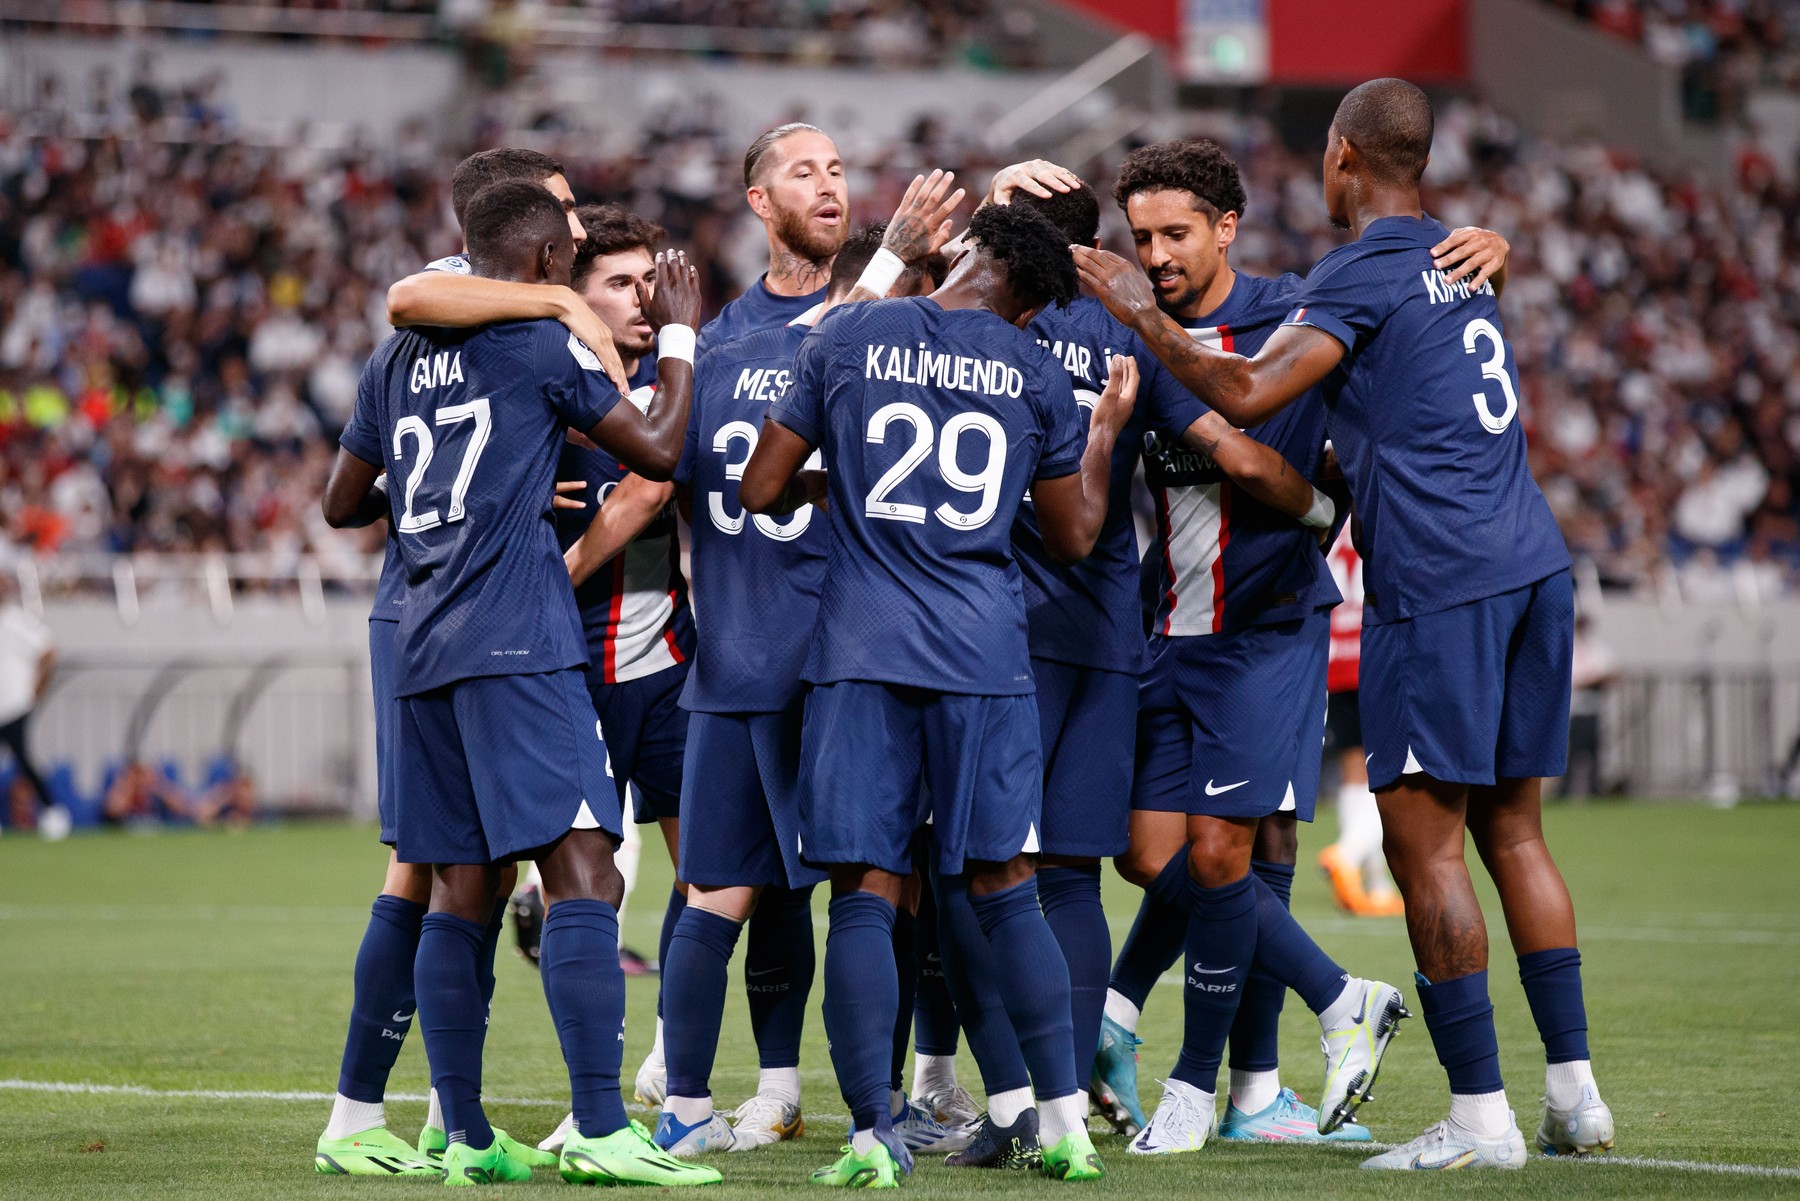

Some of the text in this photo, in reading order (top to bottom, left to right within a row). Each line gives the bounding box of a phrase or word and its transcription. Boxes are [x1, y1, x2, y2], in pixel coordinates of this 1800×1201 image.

[410, 351, 465, 393] GANA
[1463, 318, 1518, 434] 3
[393, 398, 492, 534] 27
[865, 402, 1008, 531] 29
[1165, 454, 1217, 473] AIRW
[745, 983, 790, 993] PARIS
[1187, 976, 1237, 993] PARIS
